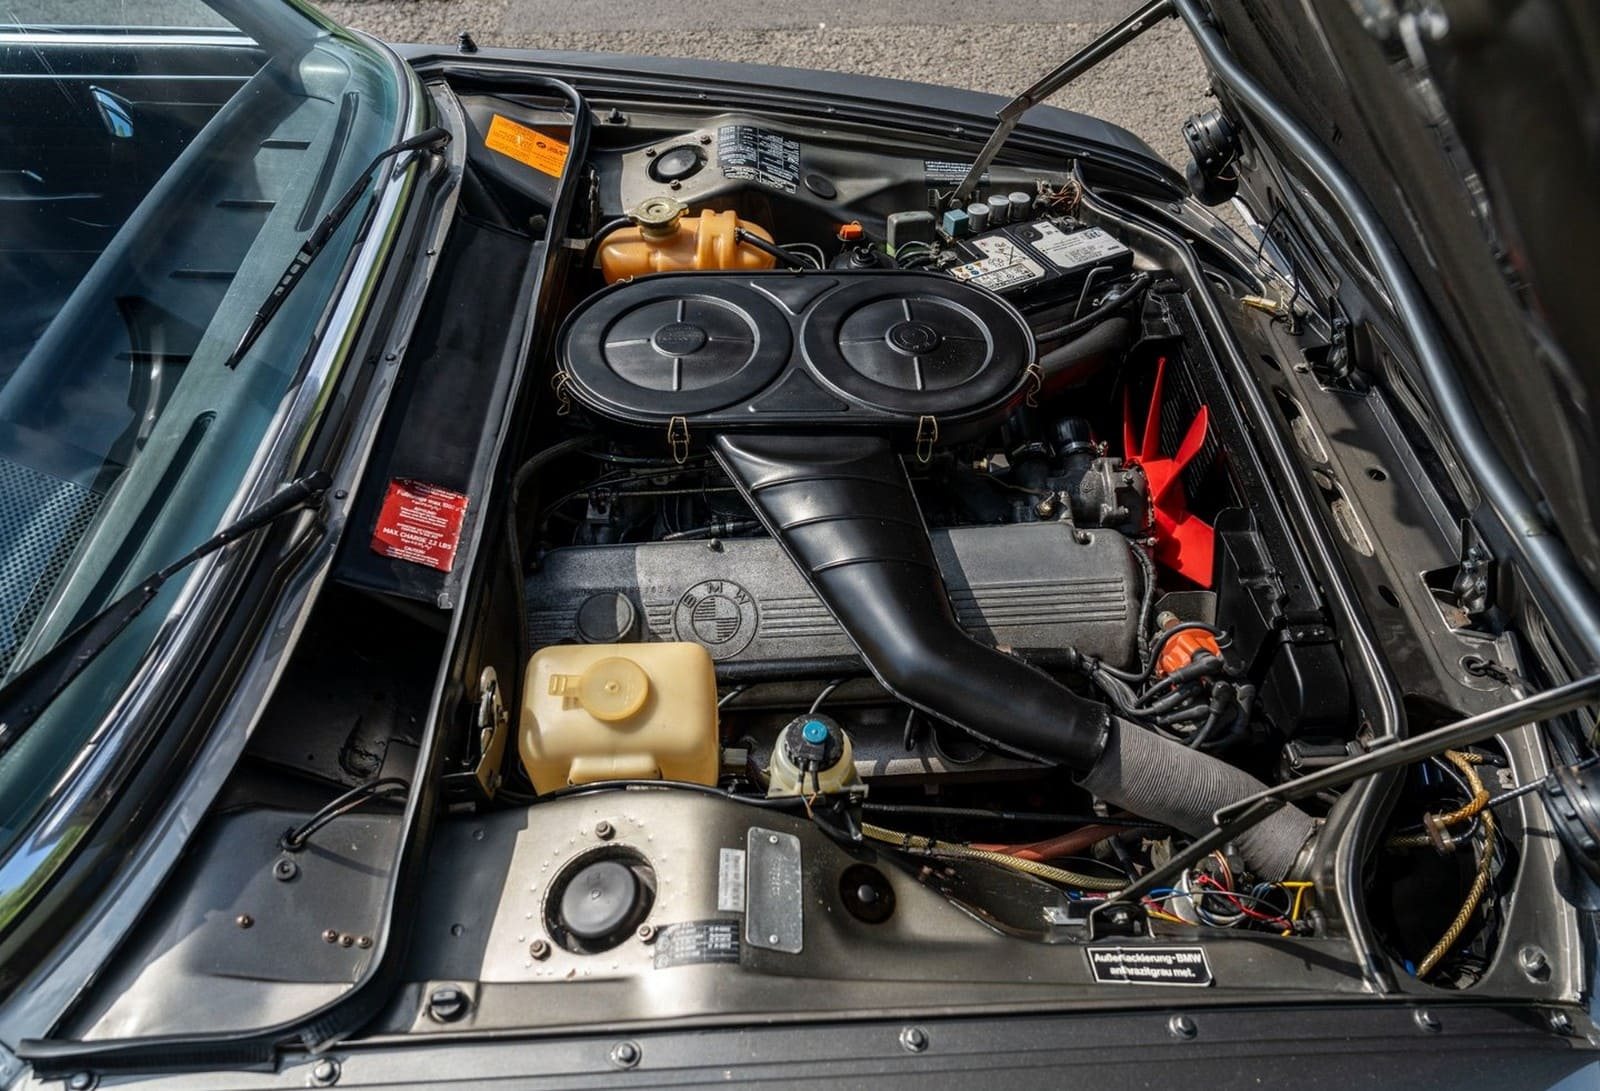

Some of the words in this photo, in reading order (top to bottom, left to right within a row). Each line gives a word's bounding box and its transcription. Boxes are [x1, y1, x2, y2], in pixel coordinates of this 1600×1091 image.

[400, 532, 427, 543] CHARGE
[438, 541, 452, 550] LBS
[682, 582, 750, 608] BMW
